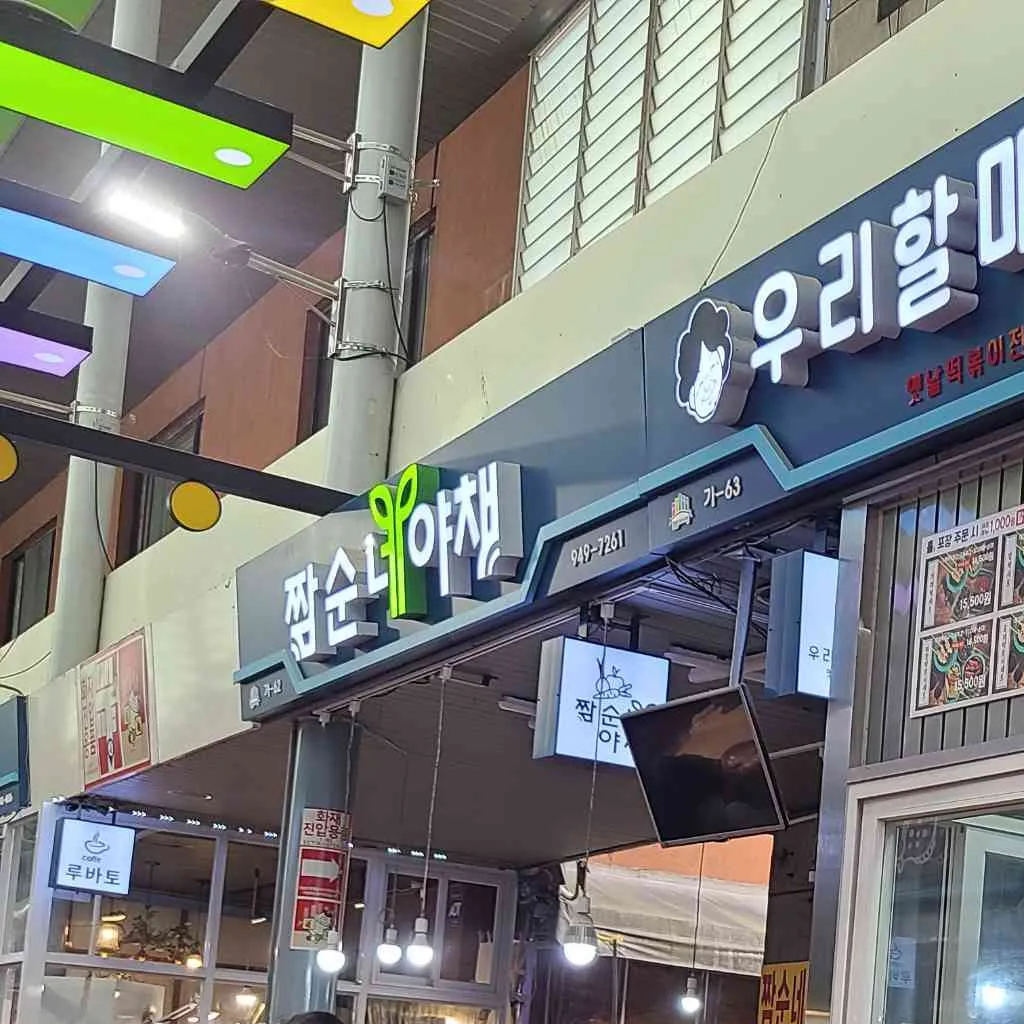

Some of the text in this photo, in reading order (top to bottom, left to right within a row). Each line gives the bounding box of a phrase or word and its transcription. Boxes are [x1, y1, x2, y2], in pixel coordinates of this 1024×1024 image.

[703, 475, 742, 508] 가-63
[571, 528, 626, 566] 949-7261
[65, 863, 121, 886] 루바토
